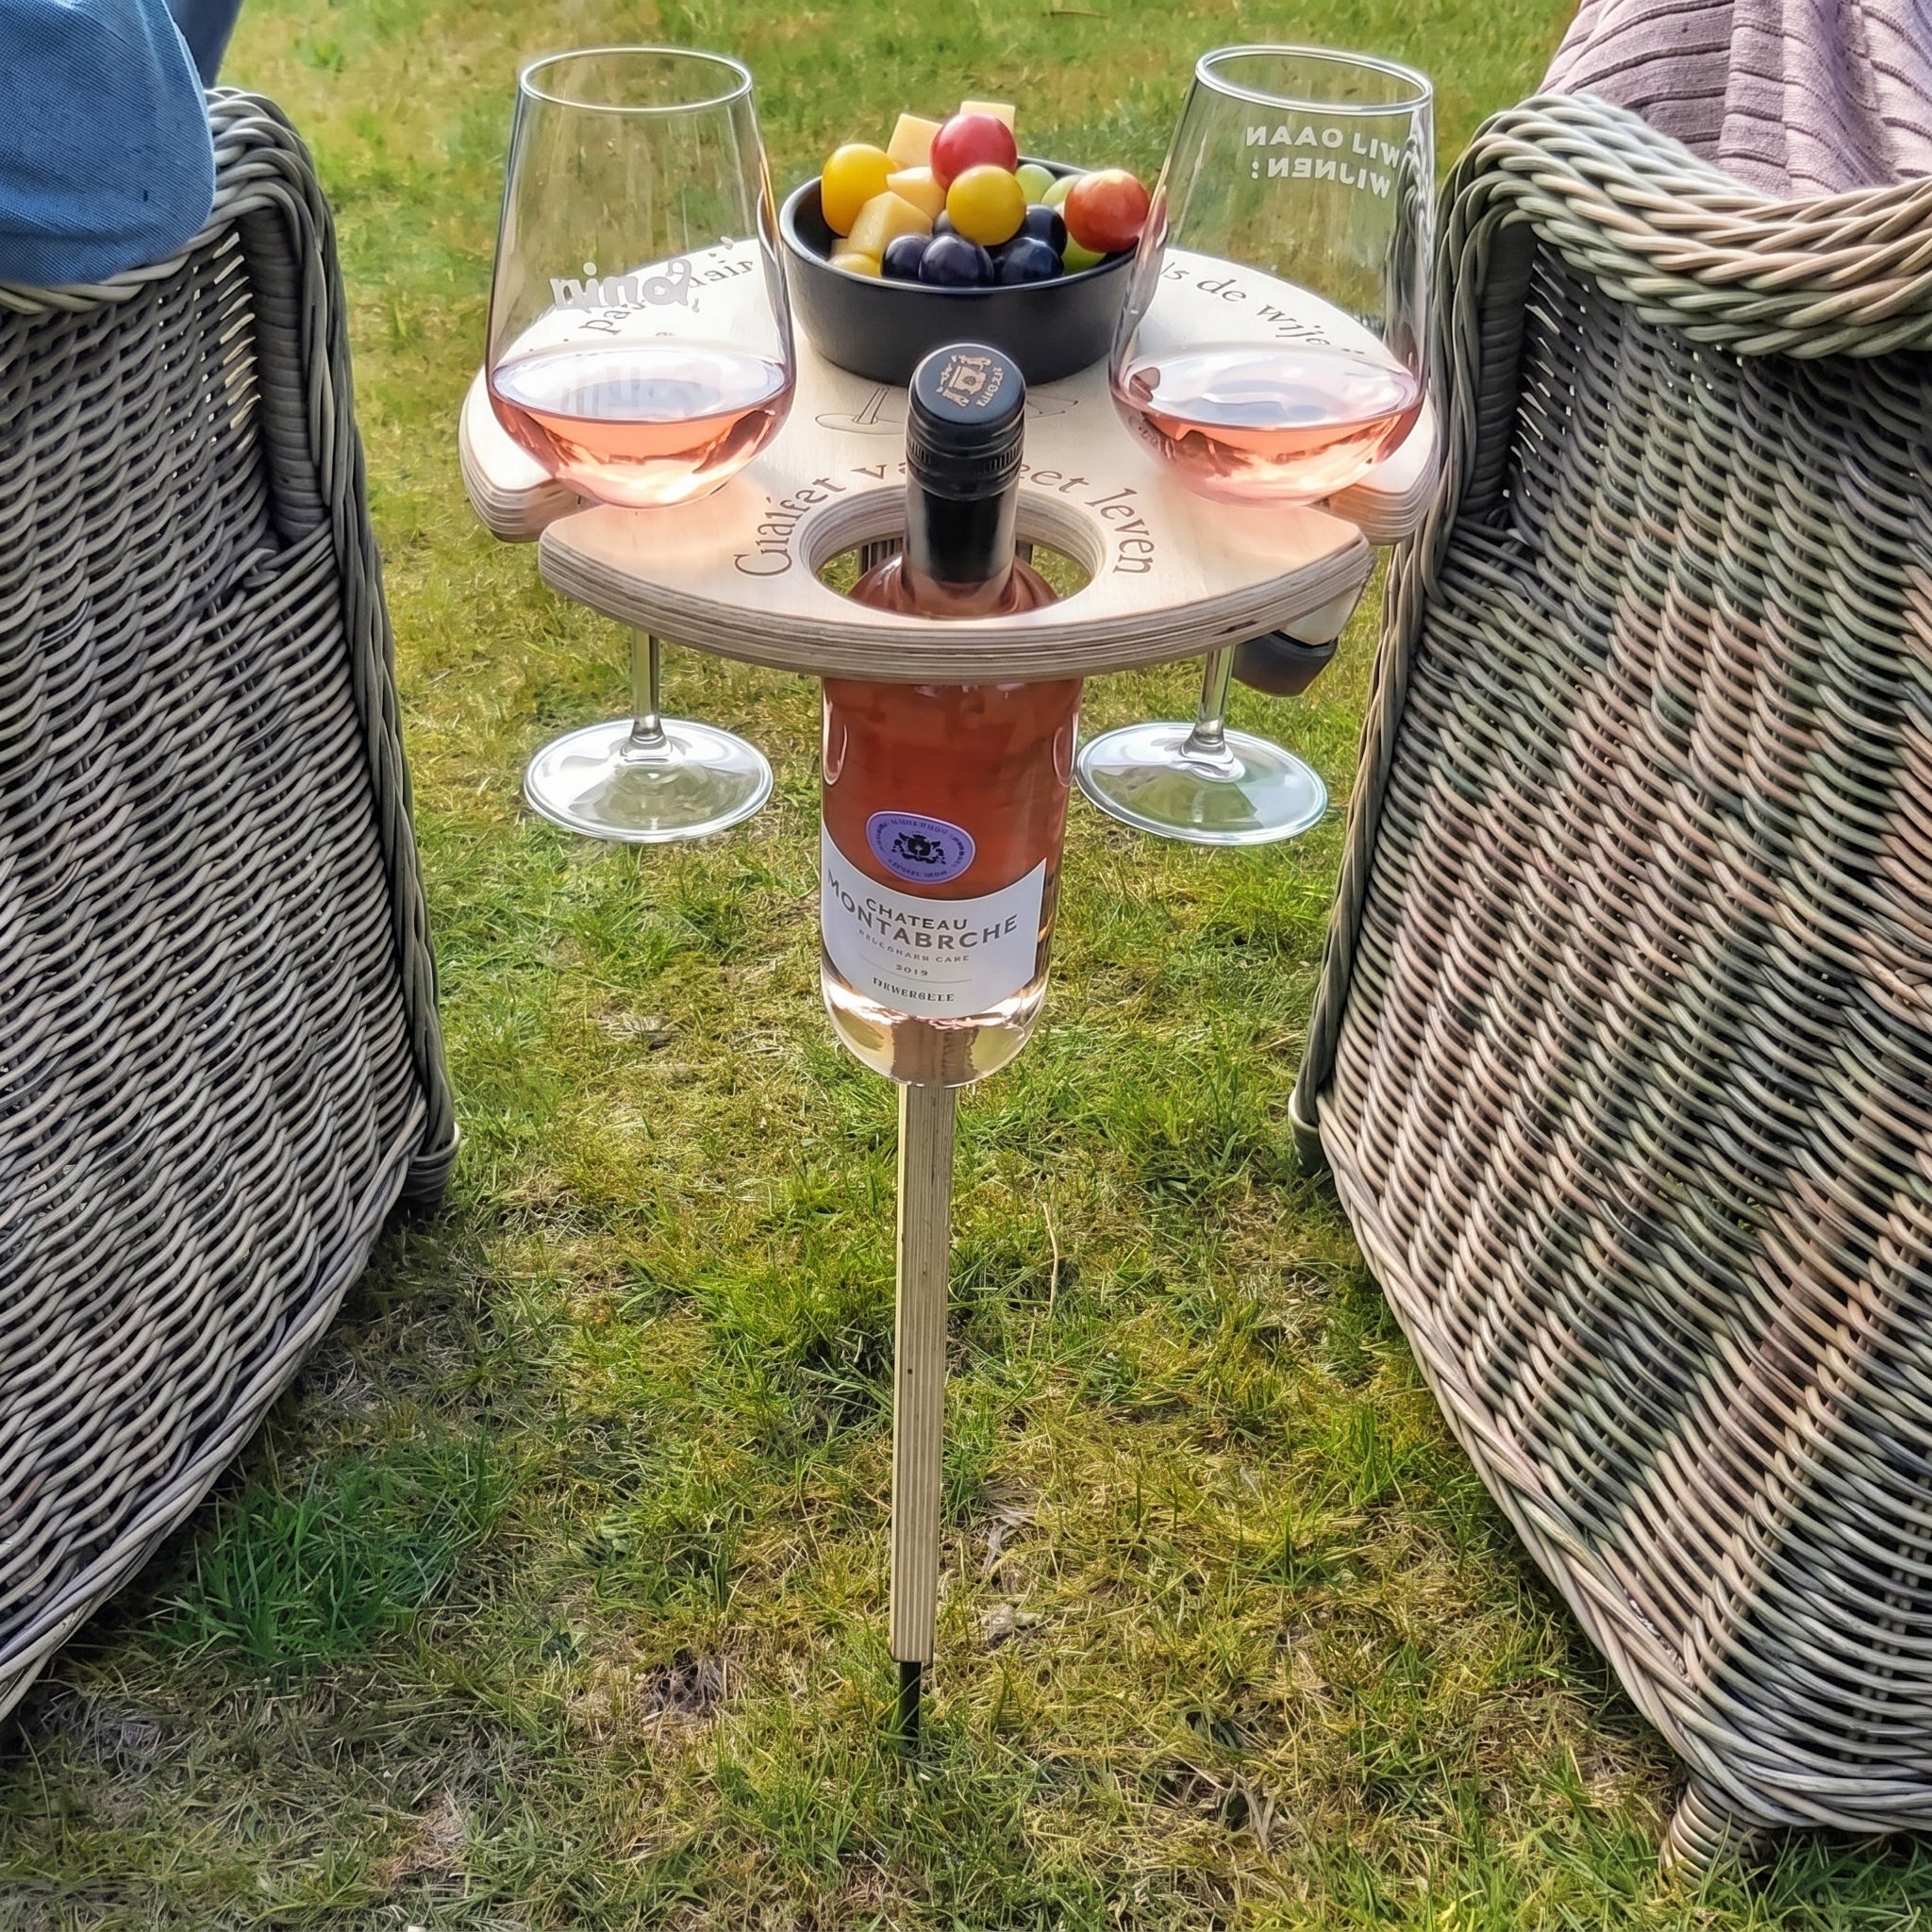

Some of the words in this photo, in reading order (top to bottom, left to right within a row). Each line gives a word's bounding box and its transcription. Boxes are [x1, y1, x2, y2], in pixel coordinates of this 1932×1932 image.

[1196, 278, 1246, 302] de
[1085, 487, 1156, 574] leven
[827, 867, 1018, 950] MONTABRCHE
[865, 897, 968, 930] CHATEAU
